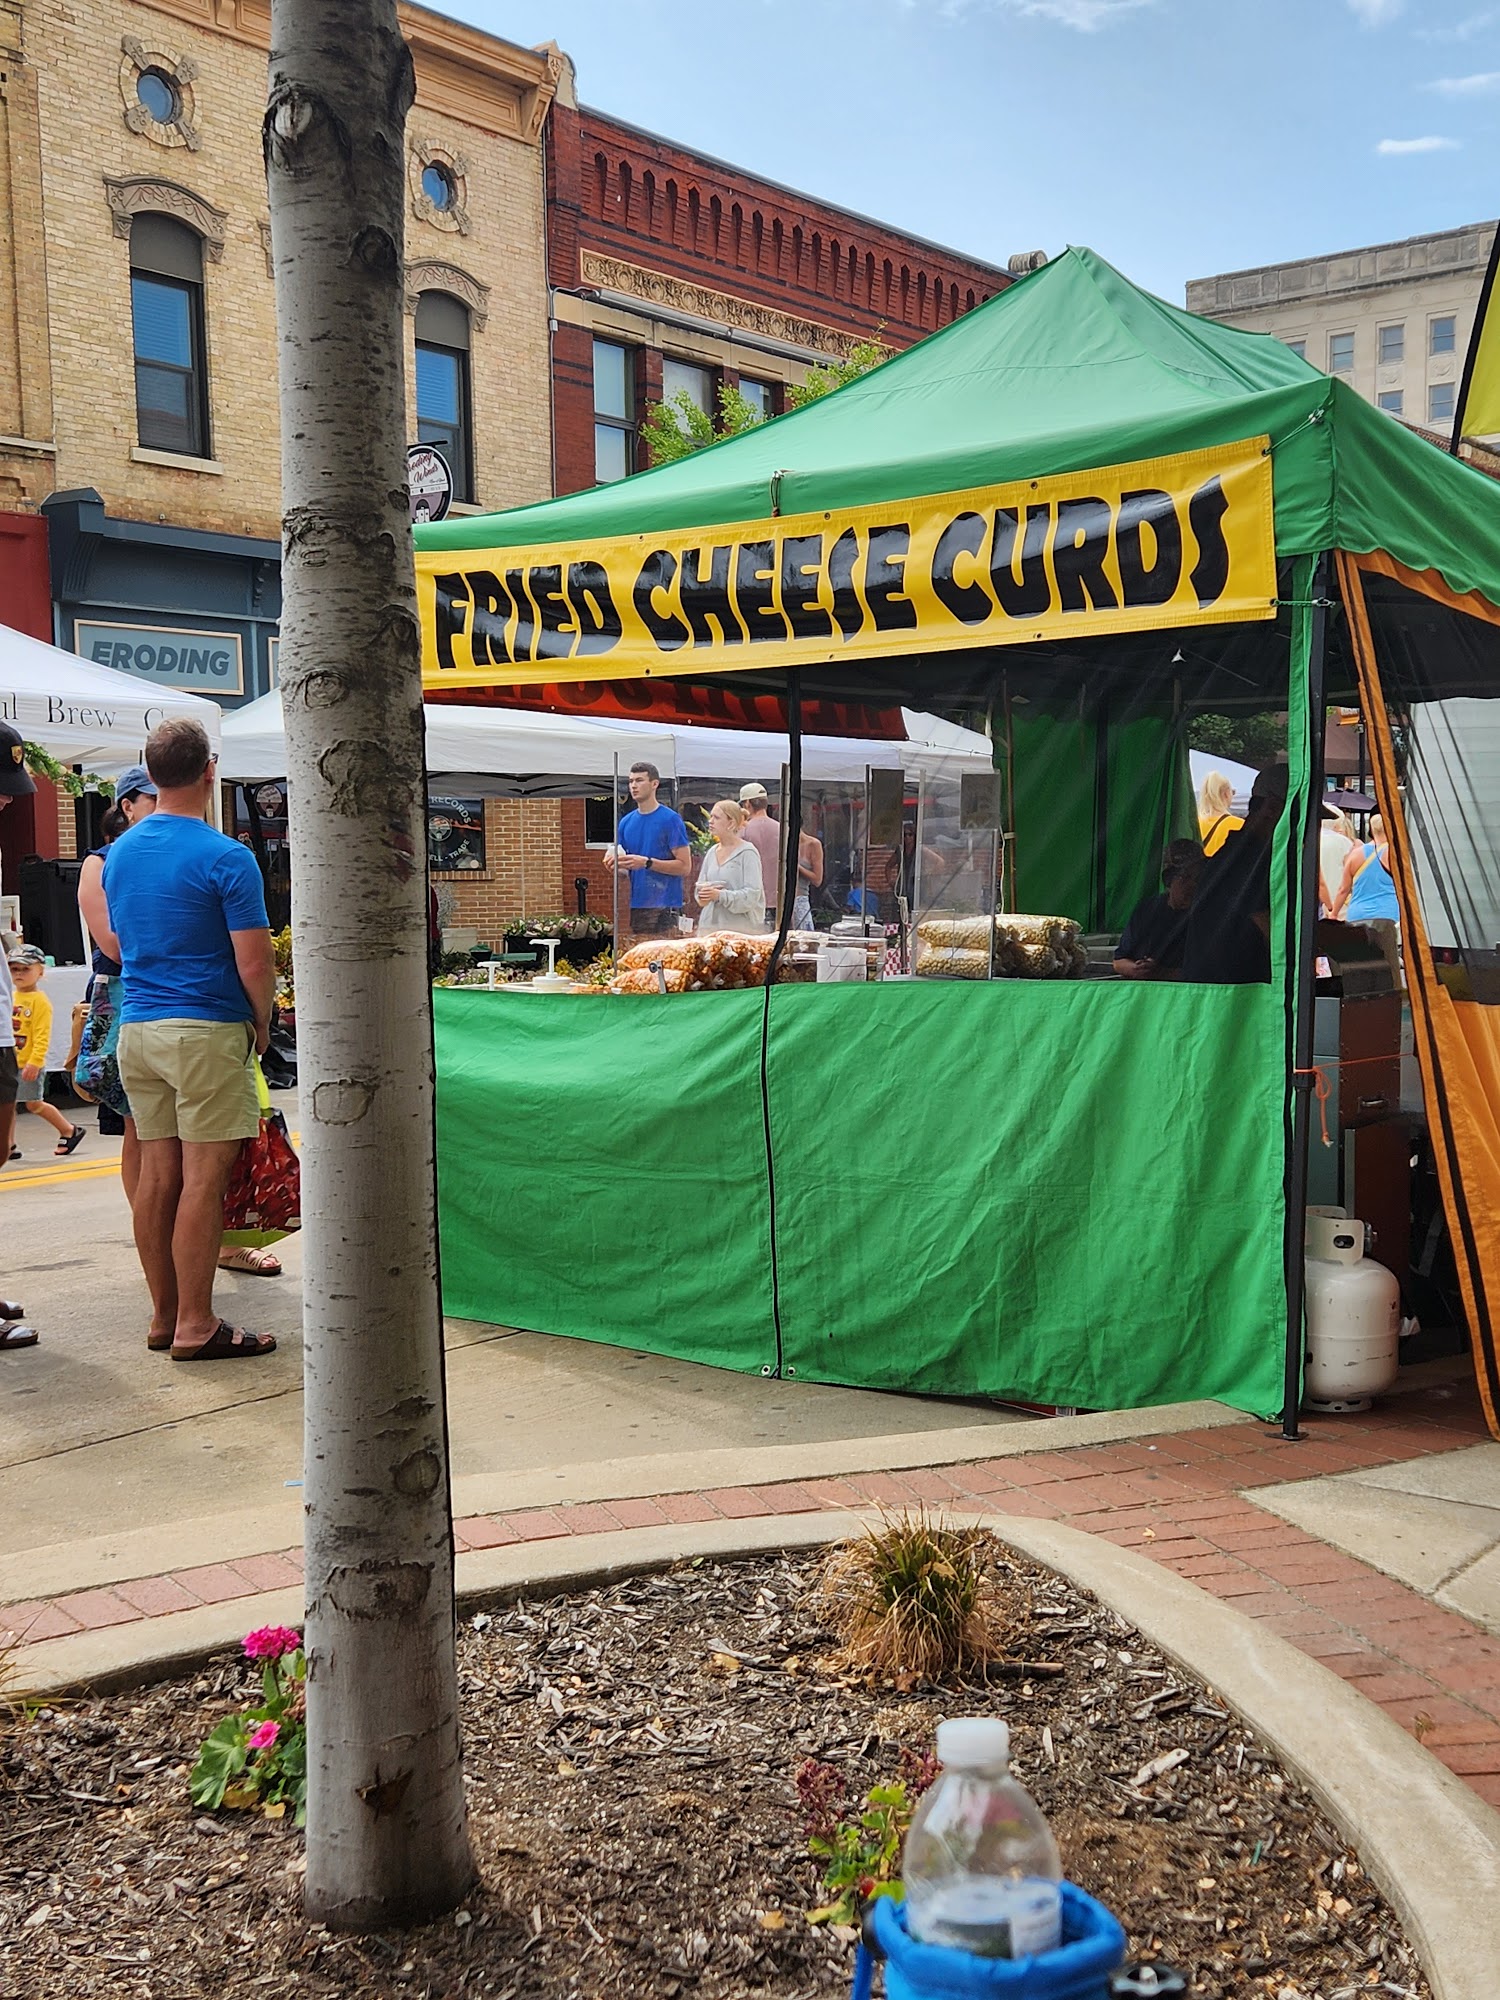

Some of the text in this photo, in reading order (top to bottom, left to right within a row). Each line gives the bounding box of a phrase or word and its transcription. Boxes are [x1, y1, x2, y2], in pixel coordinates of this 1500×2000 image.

[433, 474, 1230, 670] FRIED CHEESE CURDS
[91, 640, 230, 676] ERODING
[44, 695, 117, 728] Brew
[430, 796, 472, 824] RECORDS
[448, 839, 470, 859] TRADE
